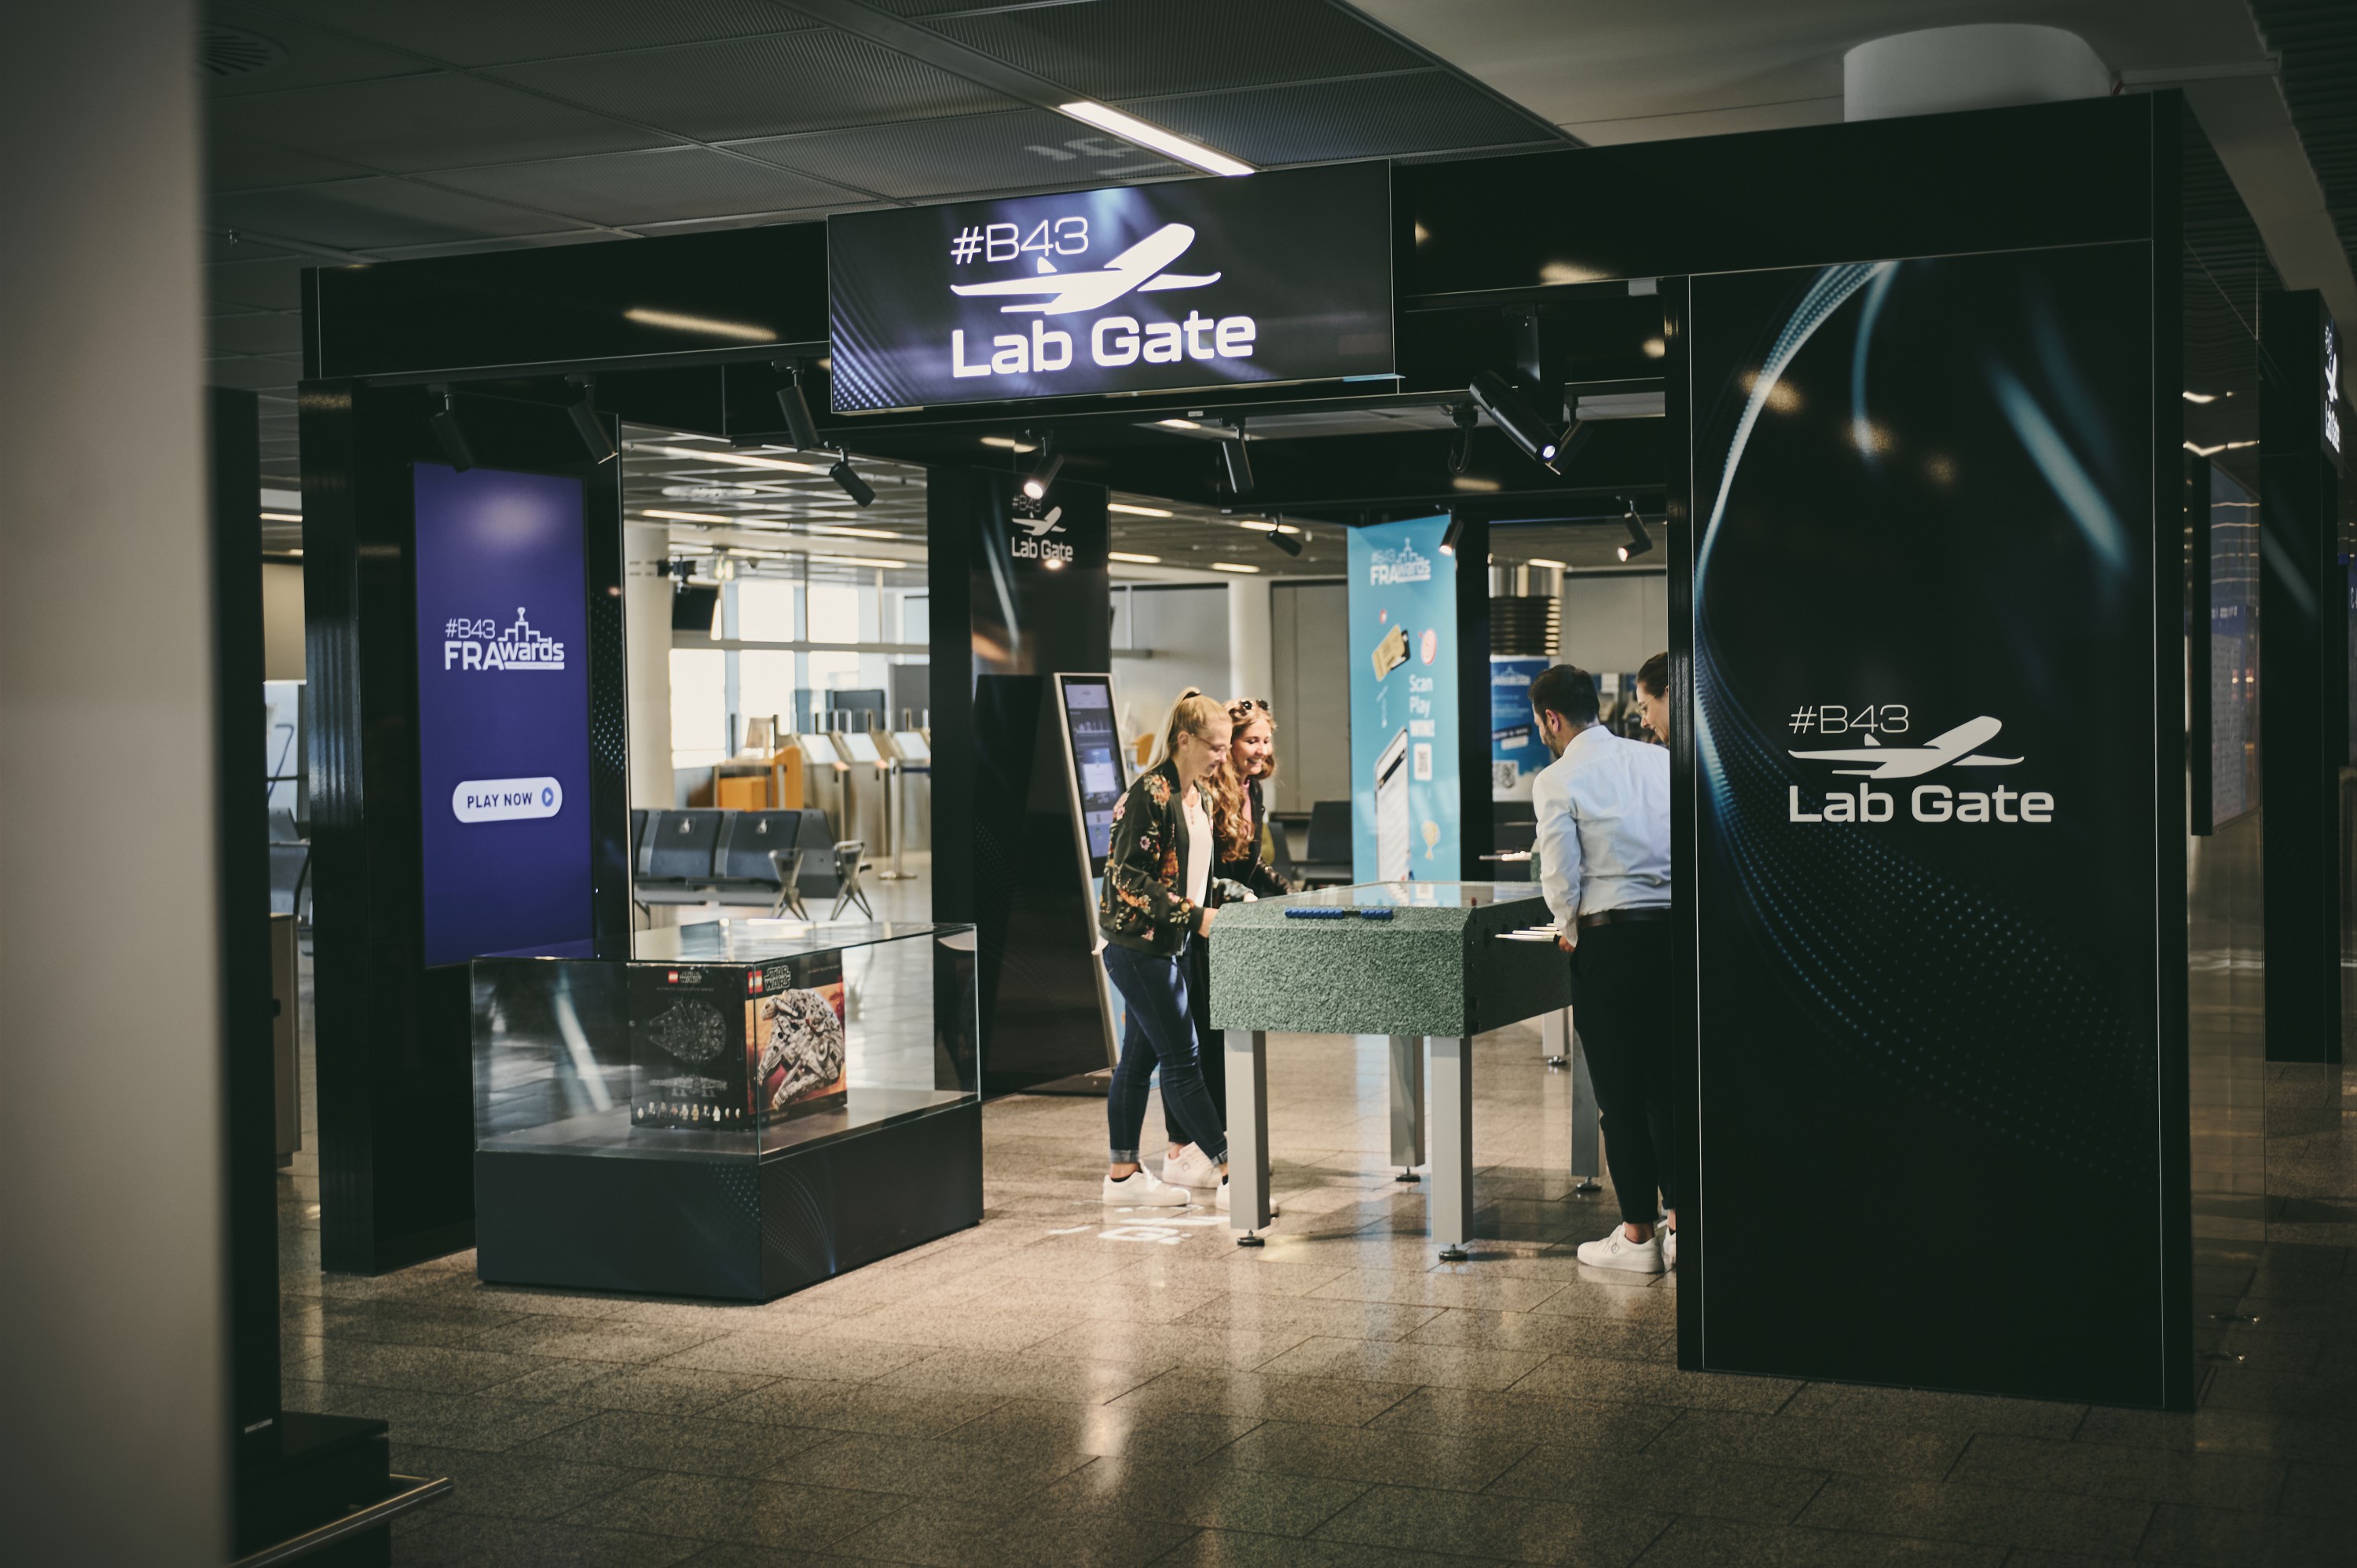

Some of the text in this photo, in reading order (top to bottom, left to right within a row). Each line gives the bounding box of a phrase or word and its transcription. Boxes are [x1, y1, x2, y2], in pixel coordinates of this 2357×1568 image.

[951, 217, 1089, 265] #B43
[951, 310, 1256, 379] Lab Gate
[1012, 537, 1073, 562] Lab Gate
[445, 618, 496, 639] #B43
[445, 637, 565, 670] FRAwards
[1409, 674, 1433, 691] Scan
[1409, 696, 1431, 717] Play
[1788, 704, 1910, 734] #B43
[467, 792, 533, 809] PLAY NOW
[1789, 782, 2055, 822] Lab Gate
[764, 965, 791, 980] STAR
[764, 976, 791, 991] WARS
